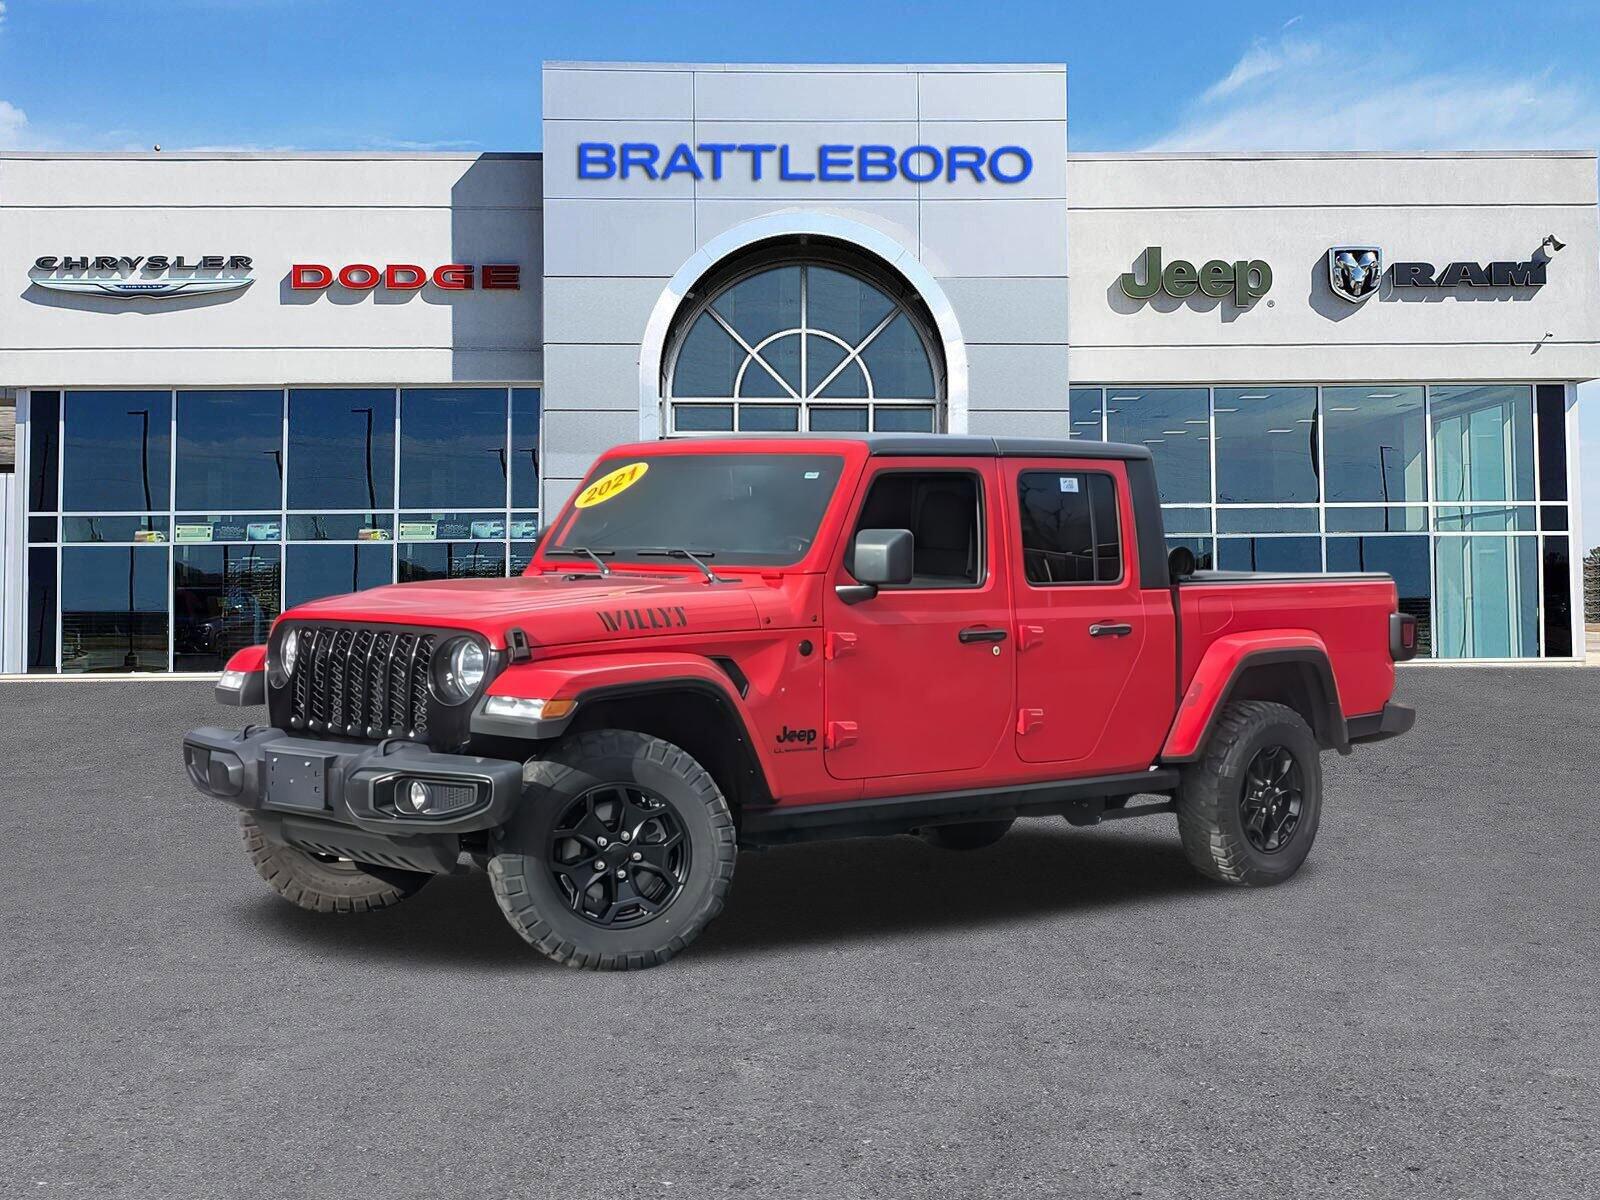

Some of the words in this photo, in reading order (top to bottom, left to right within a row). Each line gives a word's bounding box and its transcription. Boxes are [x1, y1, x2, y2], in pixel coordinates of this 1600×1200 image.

[577, 142, 1034, 184] BRATTLEBORO
[35, 256, 254, 271] CHRYSLER
[1121, 246, 1273, 307] Jeep
[1392, 261, 1547, 288] RAM
[291, 264, 520, 290] DODGE
[583, 466, 637, 504] 2021
[596, 606, 687, 632] WILLYS
[776, 725, 817, 745] Jeep
